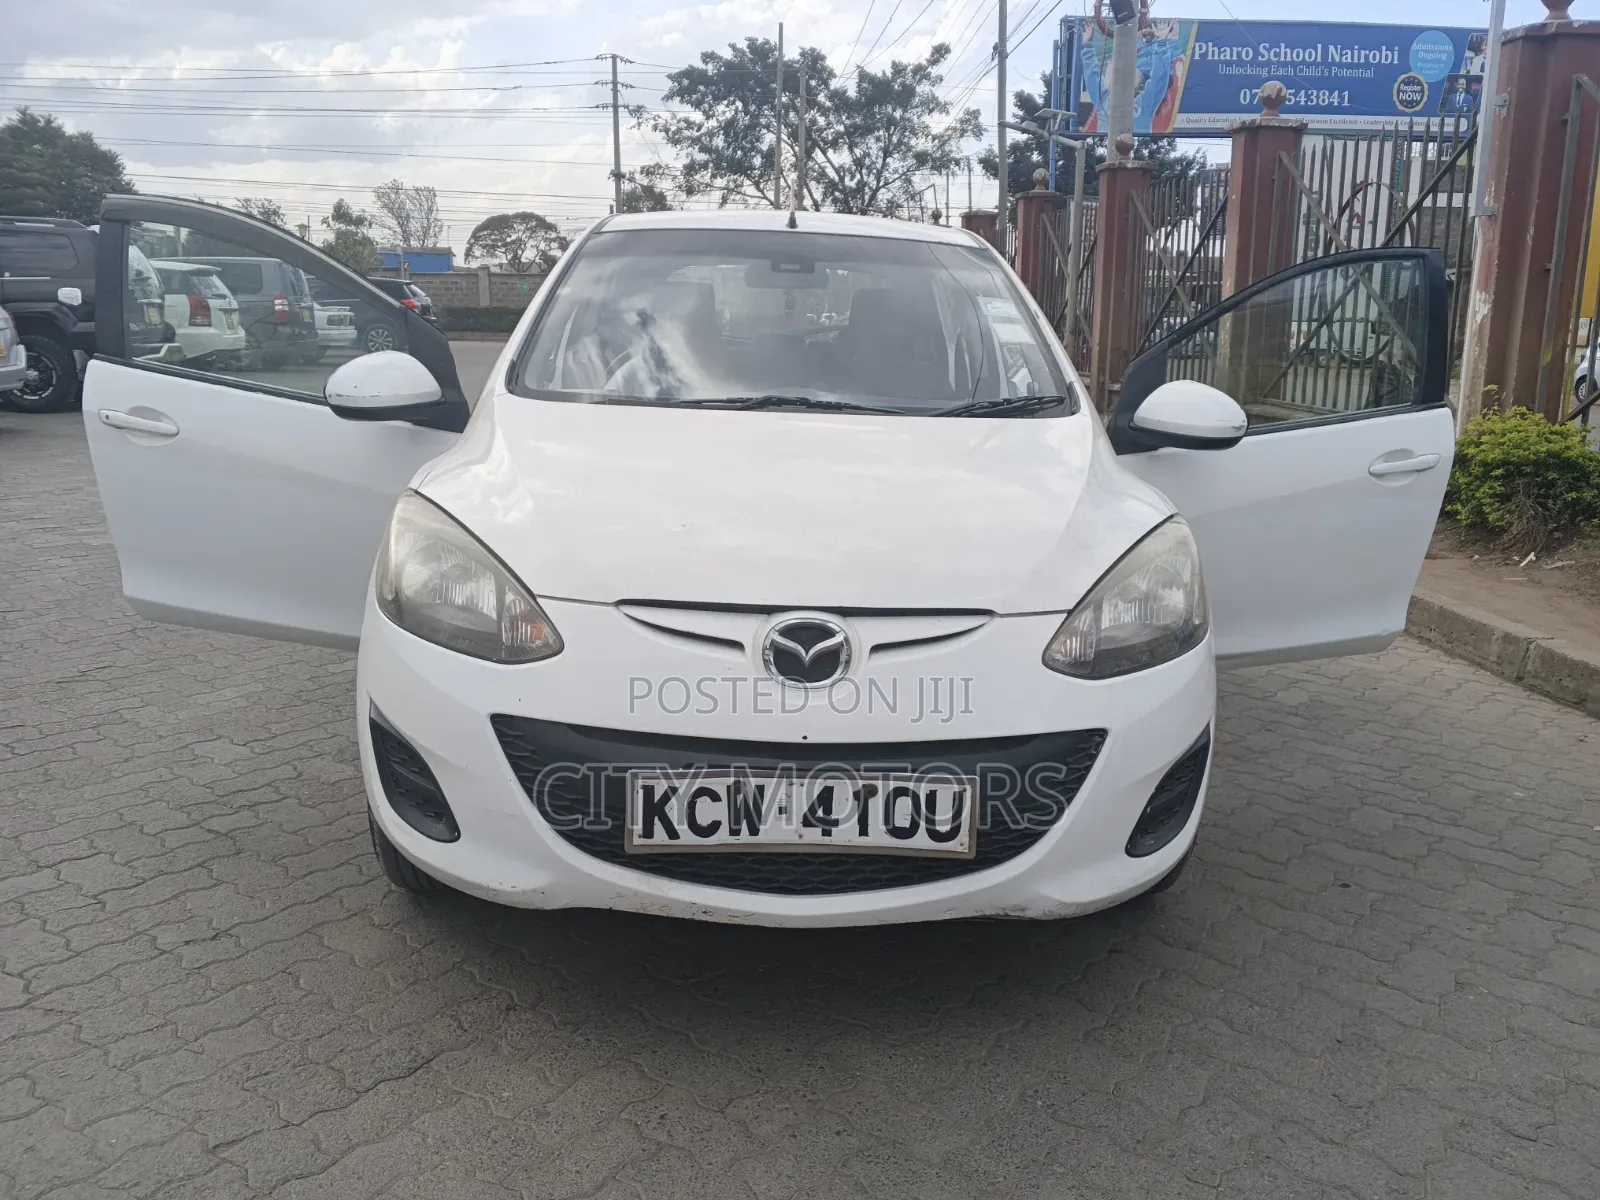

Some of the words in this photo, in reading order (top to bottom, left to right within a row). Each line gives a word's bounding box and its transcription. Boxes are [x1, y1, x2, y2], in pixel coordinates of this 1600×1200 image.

[1412, 43, 1453, 51] Admissions
[1193, 42, 1253, 60] Pharo
[1258, 43, 1322, 62] School
[1328, 45, 1399, 64] Nairobi
[1418, 51, 1447, 60] Ongoing
[1219, 64, 1268, 77] Unlocking
[1271, 65, 1294, 76] Each
[1297, 65, 1329, 77] Child's
[1331, 66, 1374, 77] Potential
[1400, 83, 1422, 92] Register
[1240, 88, 1350, 106] 07543841
[1399, 91, 1422, 101] NOW
[1186, 116, 1206, 124] Quality
[1363, 119, 1394, 127] Leadership
[641, 784, 766, 841] KCW
[800, 784, 967, 844] 410U
